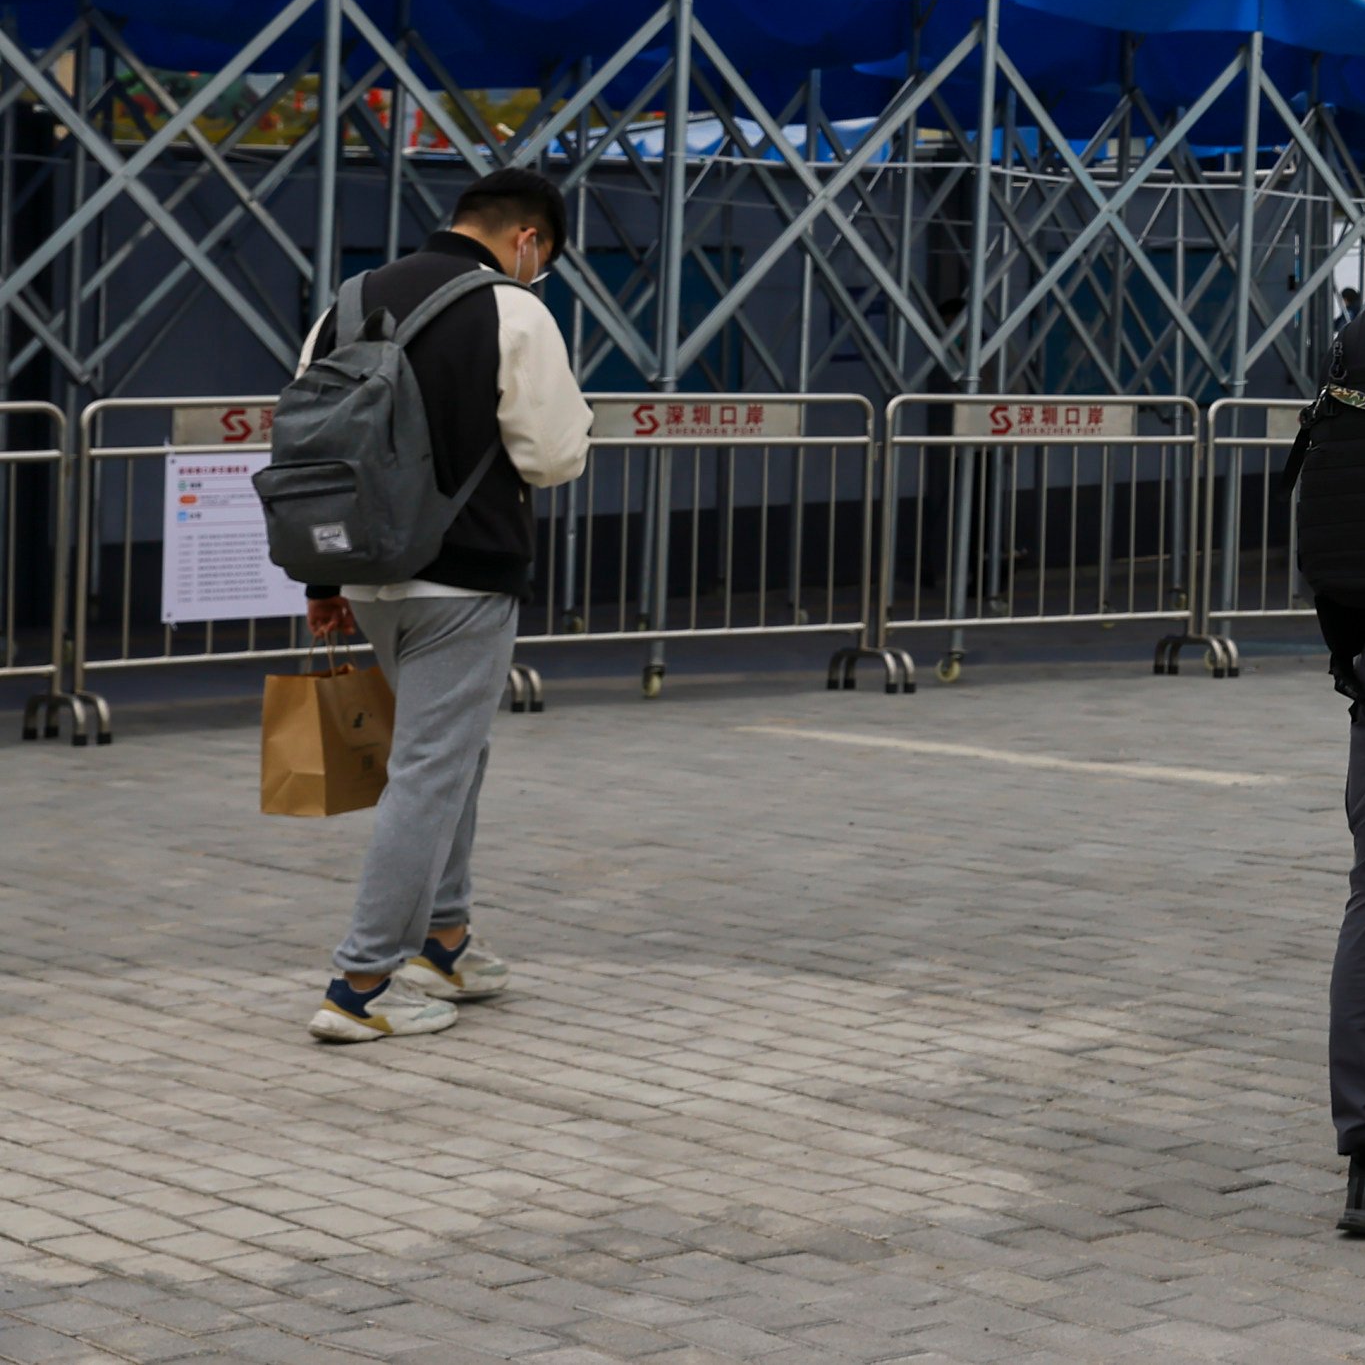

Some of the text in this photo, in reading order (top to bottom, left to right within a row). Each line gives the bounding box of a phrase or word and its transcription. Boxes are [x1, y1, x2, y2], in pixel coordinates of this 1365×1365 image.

[666, 404, 764, 425] 深圳口岸
[1018, 405, 1103, 425] 深圳口岸
[667, 427, 762, 435] SHENZHEN PORT
[1020, 427, 1102, 435] SHENZHEN PORT
